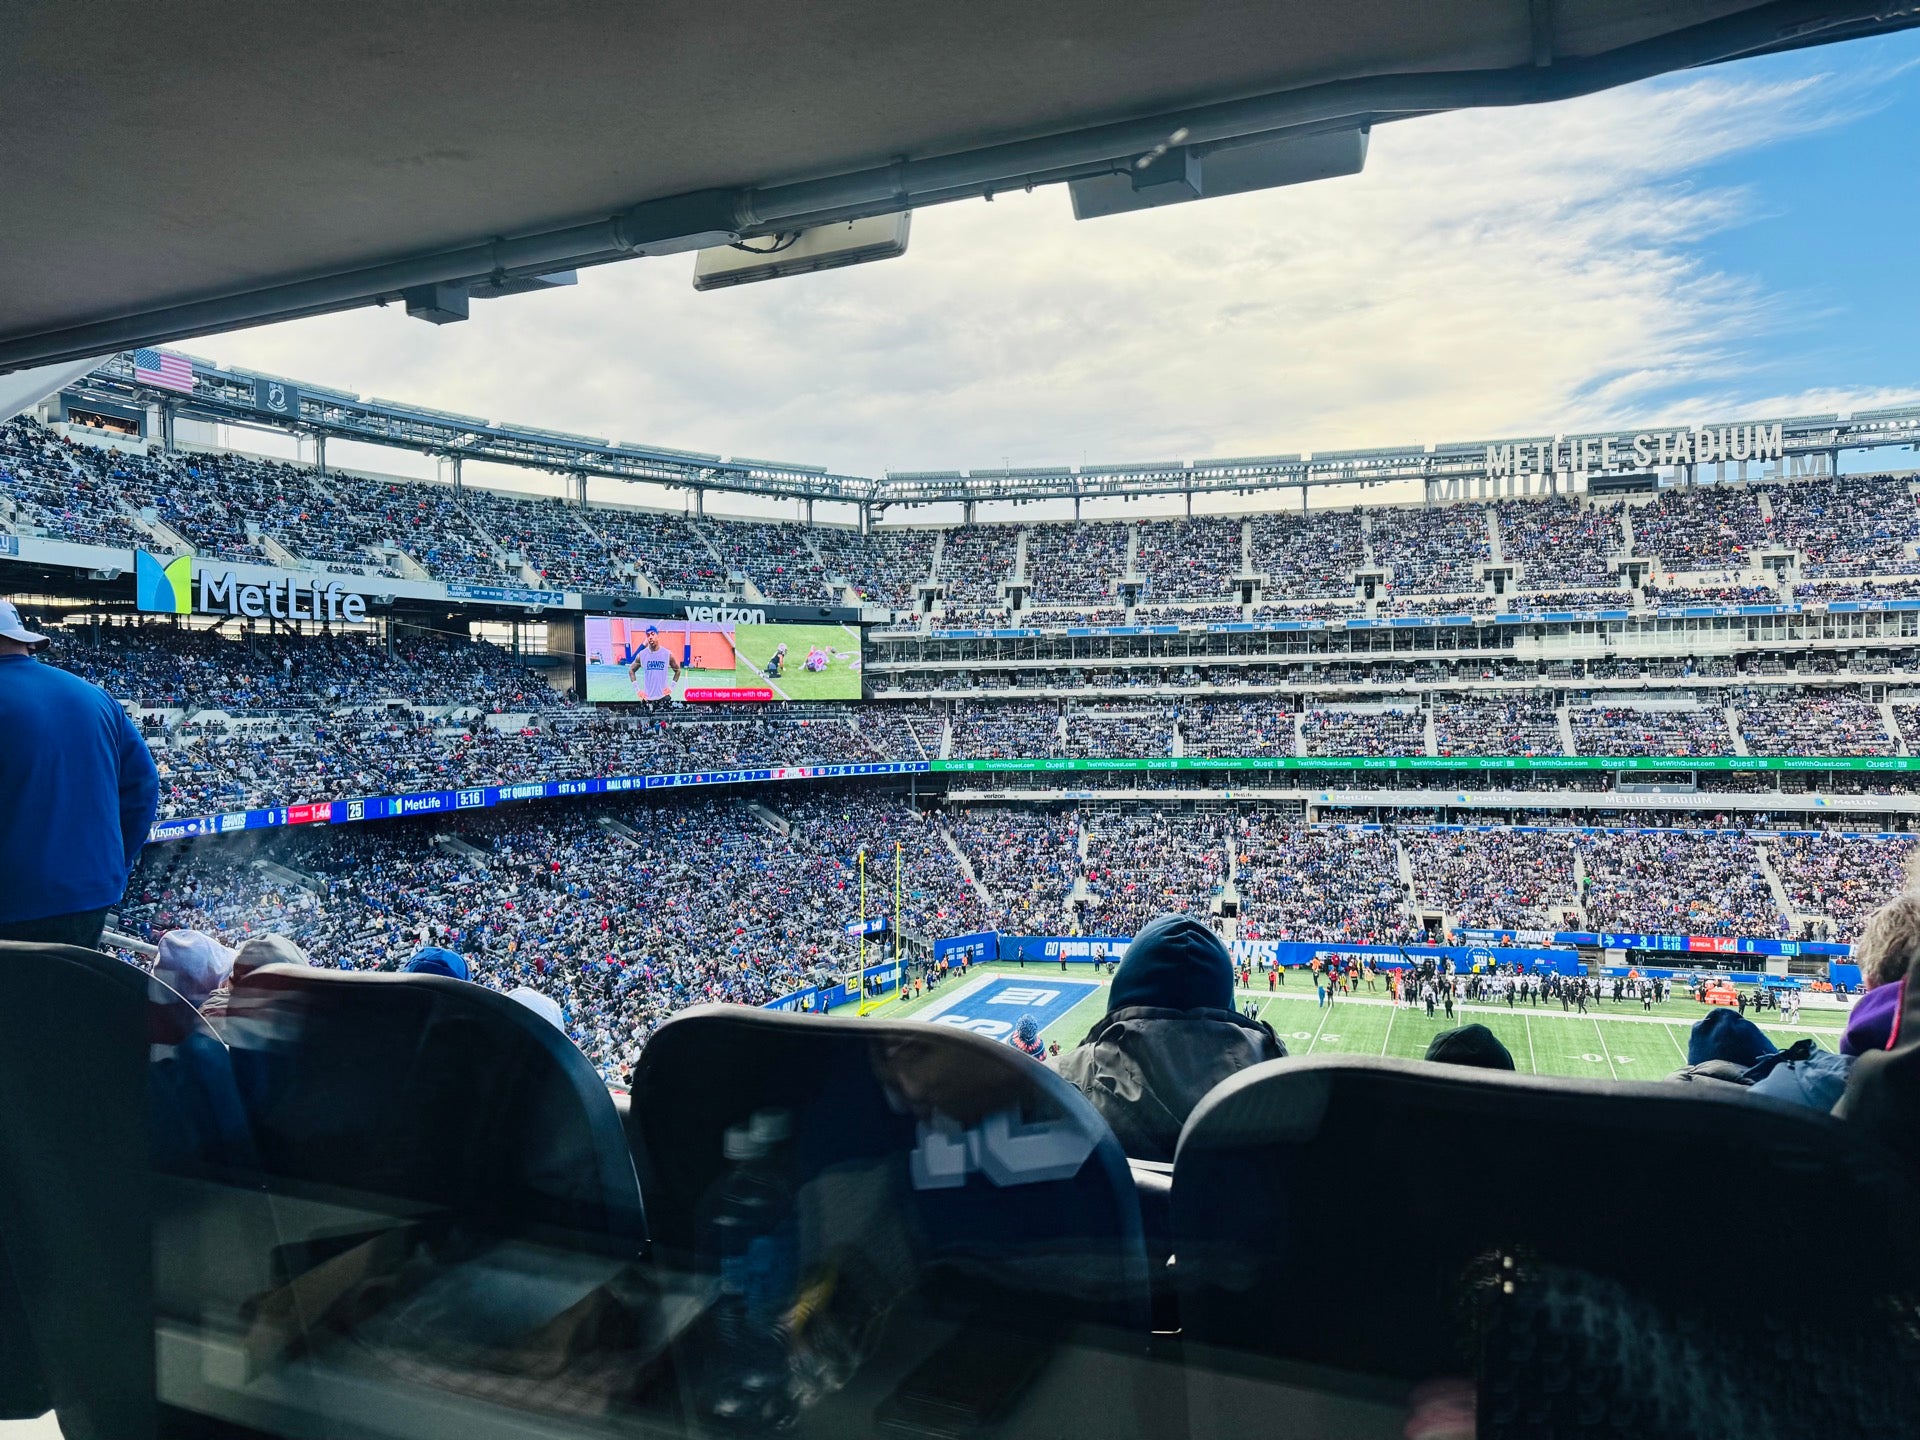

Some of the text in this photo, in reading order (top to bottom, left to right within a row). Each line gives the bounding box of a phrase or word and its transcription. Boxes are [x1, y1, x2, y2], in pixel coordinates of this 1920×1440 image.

[1485, 436, 1619, 477] METLIFE
[1633, 424, 1783, 468] STADIUM
[199, 569, 367, 622] MetLife
[684, 602, 766, 625] verizon
[647, 660, 665, 669] GIANTS
[1866, 760, 1894, 768] Quest
[558, 784, 570, 793] 1ST
[577, 783, 586, 792] 10
[606, 778, 641, 790] BALL ON 15
[460, 792, 480, 806] 5:16
[499, 786, 543, 799] 1ST QUARTER
[404, 796, 441, 811] MetLife
[1605, 796, 1713, 804] METLIFE STADIUM
[349, 803, 362, 818] 25
[221, 813, 247, 828] GIANTS
[268, 811, 275, 824] 0
[281, 814, 287, 825] 3
[200, 819, 206, 833] 3
[210, 822, 216, 834] 3
[1515, 930, 1556, 942] GIANTS
[1640, 935, 1647, 947] 3
[1044, 941, 1059, 956] GO
[1663, 942, 1681, 950] 5:16
[1746, 940, 1754, 952] 0
[848, 977, 858, 990] 25
